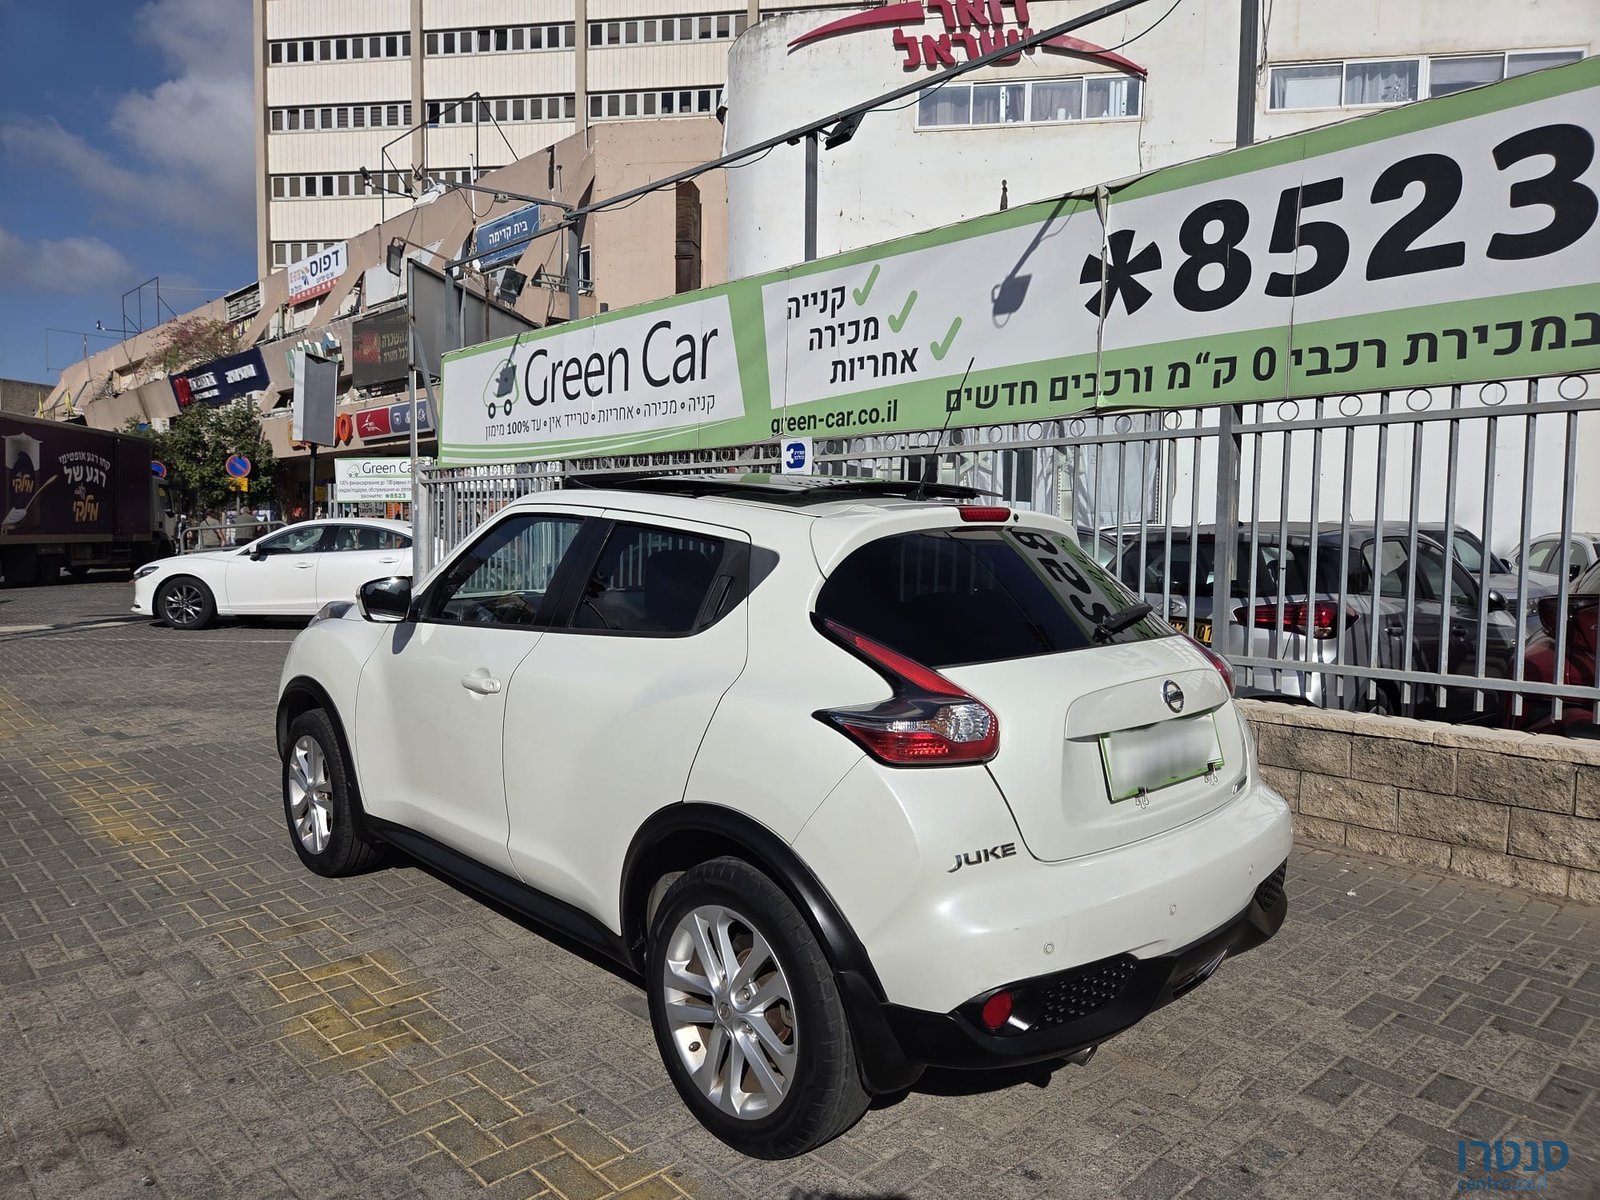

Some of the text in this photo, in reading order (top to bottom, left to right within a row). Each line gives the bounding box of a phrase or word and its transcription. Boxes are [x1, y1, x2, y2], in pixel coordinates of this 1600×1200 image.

[893, 27, 1034, 68] ישראל
[488, 220, 528, 245] בית קדימה
[309, 249, 340, 277] דפוס
[787, 285, 847, 320] קנייה
[808, 316, 880, 351] מכירה
[1402, 311, 1600, 366] במכירת
[524, 319, 719, 406] Green Car
[829, 347, 919, 384] אחריות
[1252, 346, 1277, 381] 0
[1290, 338, 1387, 377] רכבי
[946, 380, 1038, 413] חדשים
[1049, 365, 1154, 402] ורכבים
[485, 393, 716, 441] קניה מכירה אחריות טרייד אין עד 100% מימון
[770, 399, 899, 436] green-car.co.il
[63, 464, 107, 488] רגע של
[362, 461, 412, 474] Green Ca
[945, 842, 1017, 873] JUKE
